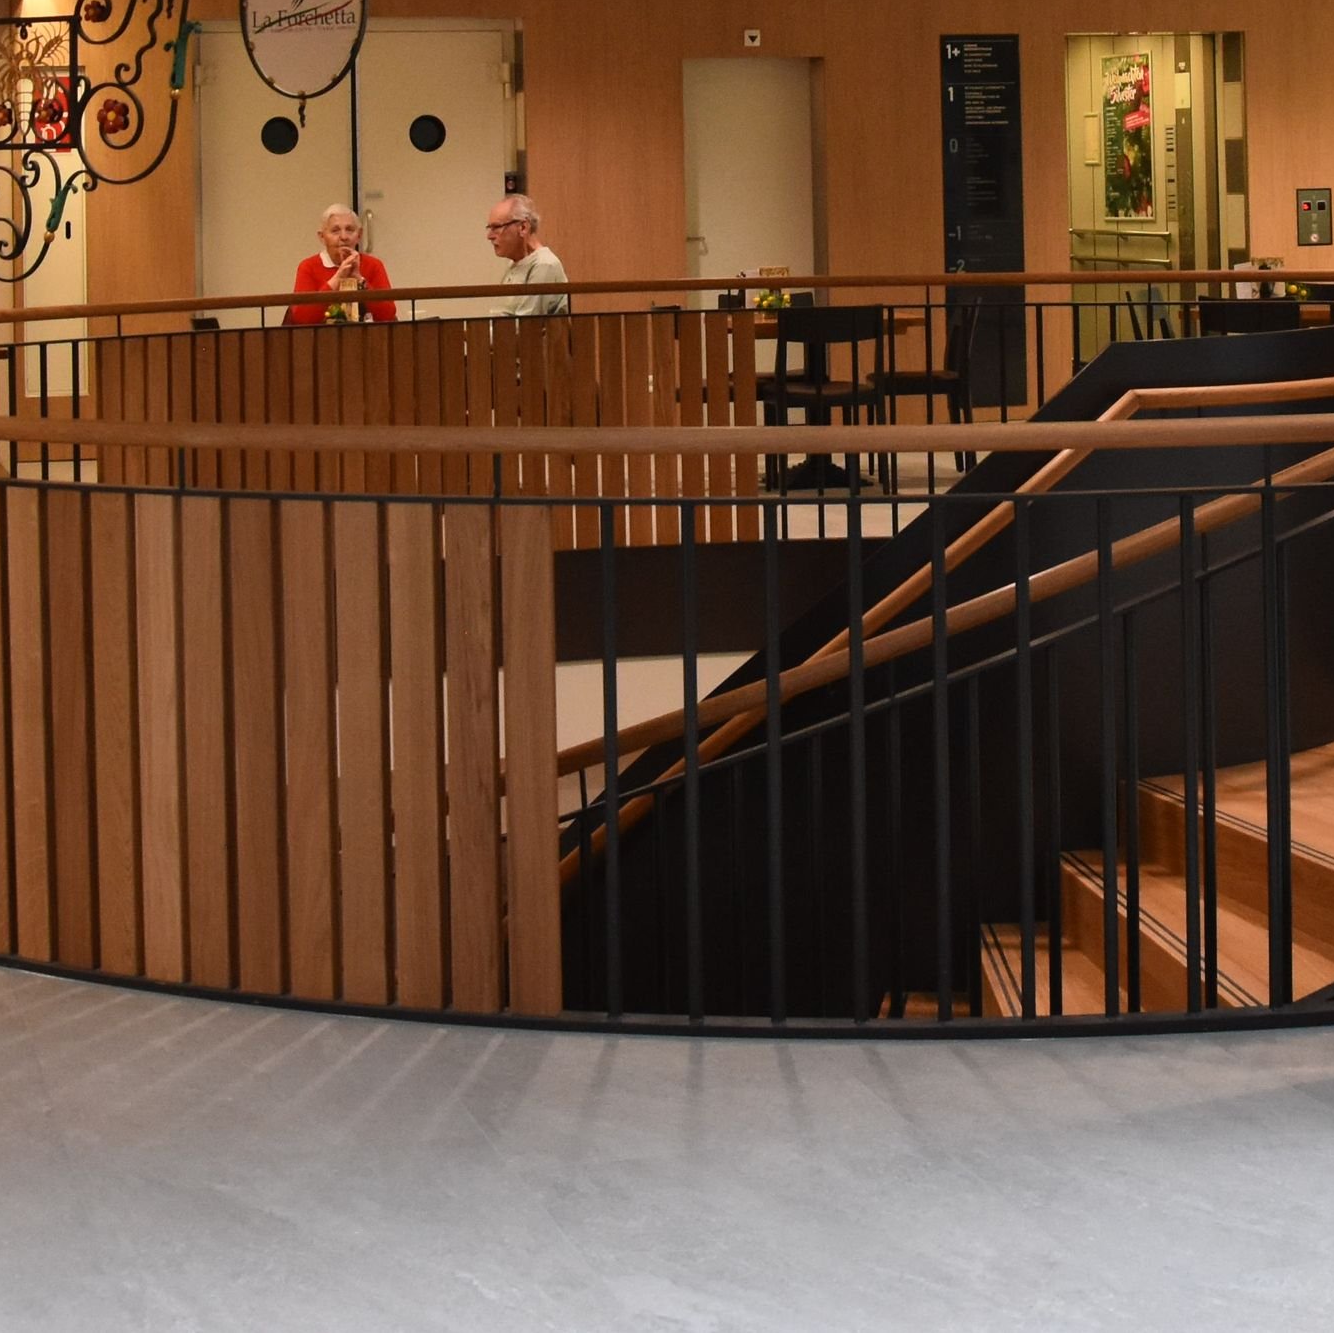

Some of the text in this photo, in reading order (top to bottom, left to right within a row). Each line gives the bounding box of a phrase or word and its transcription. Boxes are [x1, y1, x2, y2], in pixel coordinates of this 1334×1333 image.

[252, 9, 356, 28] La Forchetta
[947, 86, 955, 102] 1
